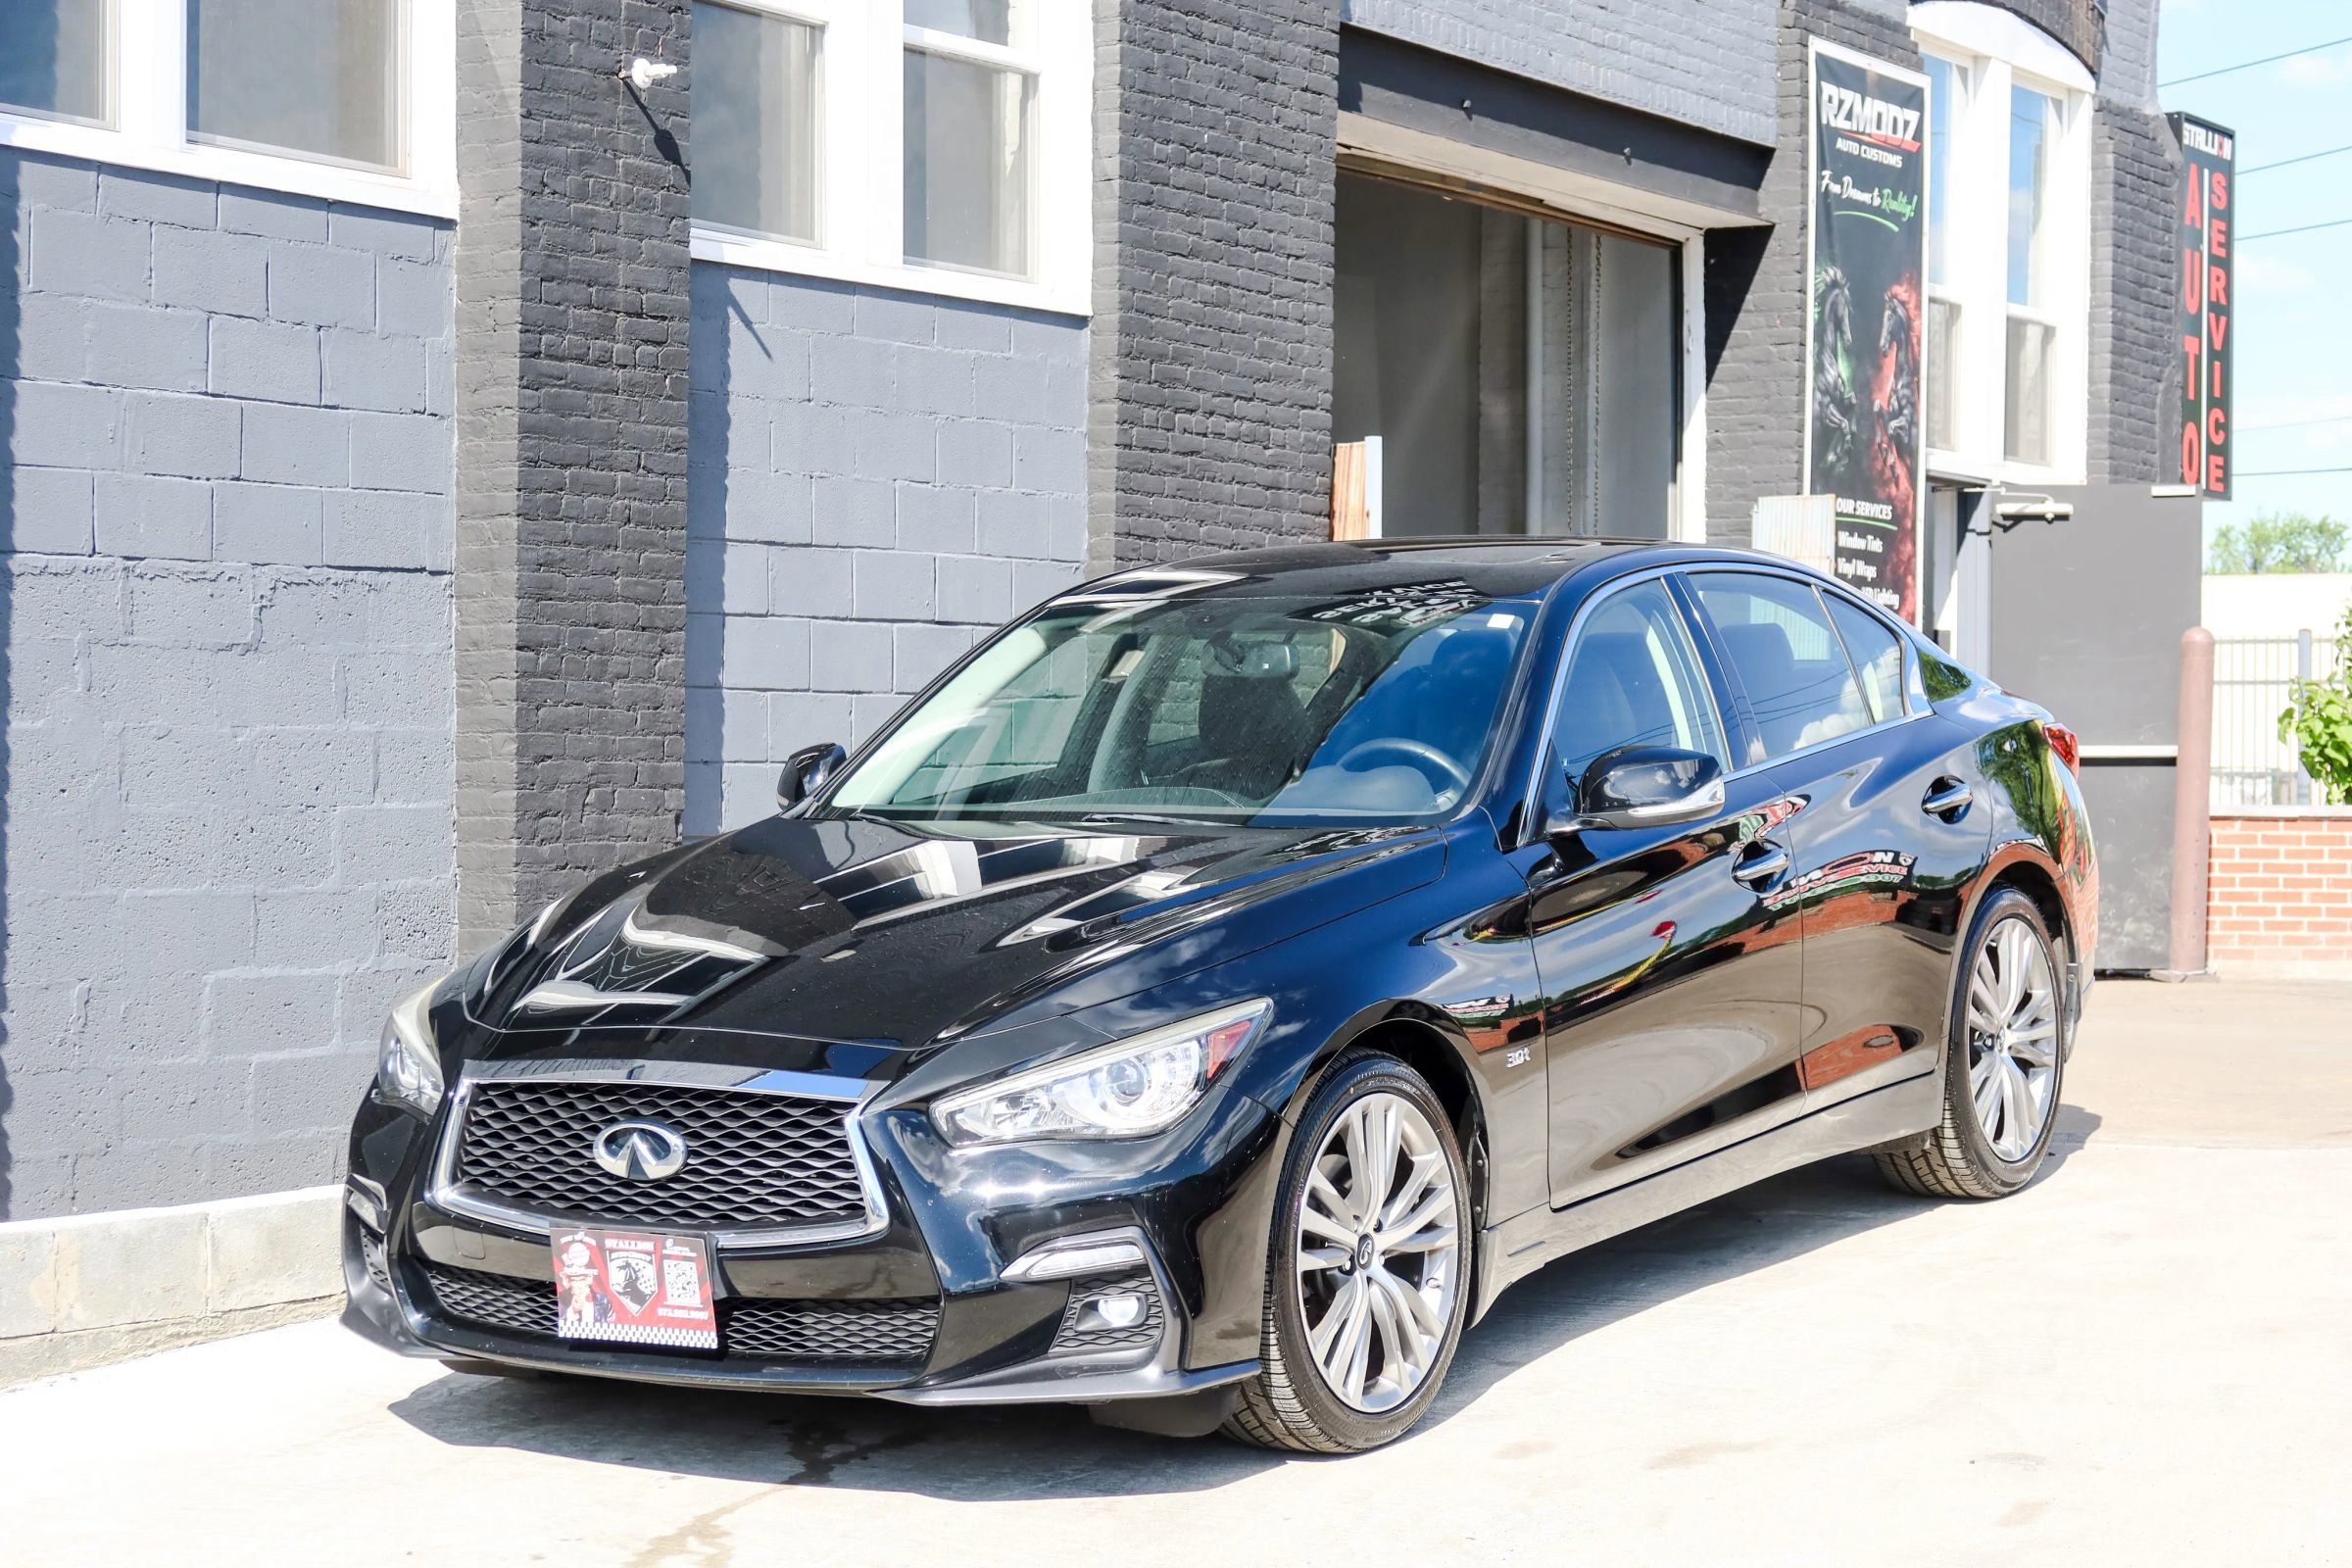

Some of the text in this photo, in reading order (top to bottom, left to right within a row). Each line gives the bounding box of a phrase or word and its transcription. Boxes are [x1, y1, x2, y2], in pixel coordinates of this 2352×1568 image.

[1820, 81, 1921, 140] RZMODZ
[1836, 137, 1903, 169] AUTO CUSTOMS
[2182, 122, 2232, 161] STALLION
[2181, 163, 2201, 485] AUTO
[2207, 172, 2229, 492] SERVICE
[1836, 497, 1892, 520] OUR SERVICES
[1838, 530, 1884, 553] Window Tints
[1837, 557, 1877, 581] Vinyl Wraps
